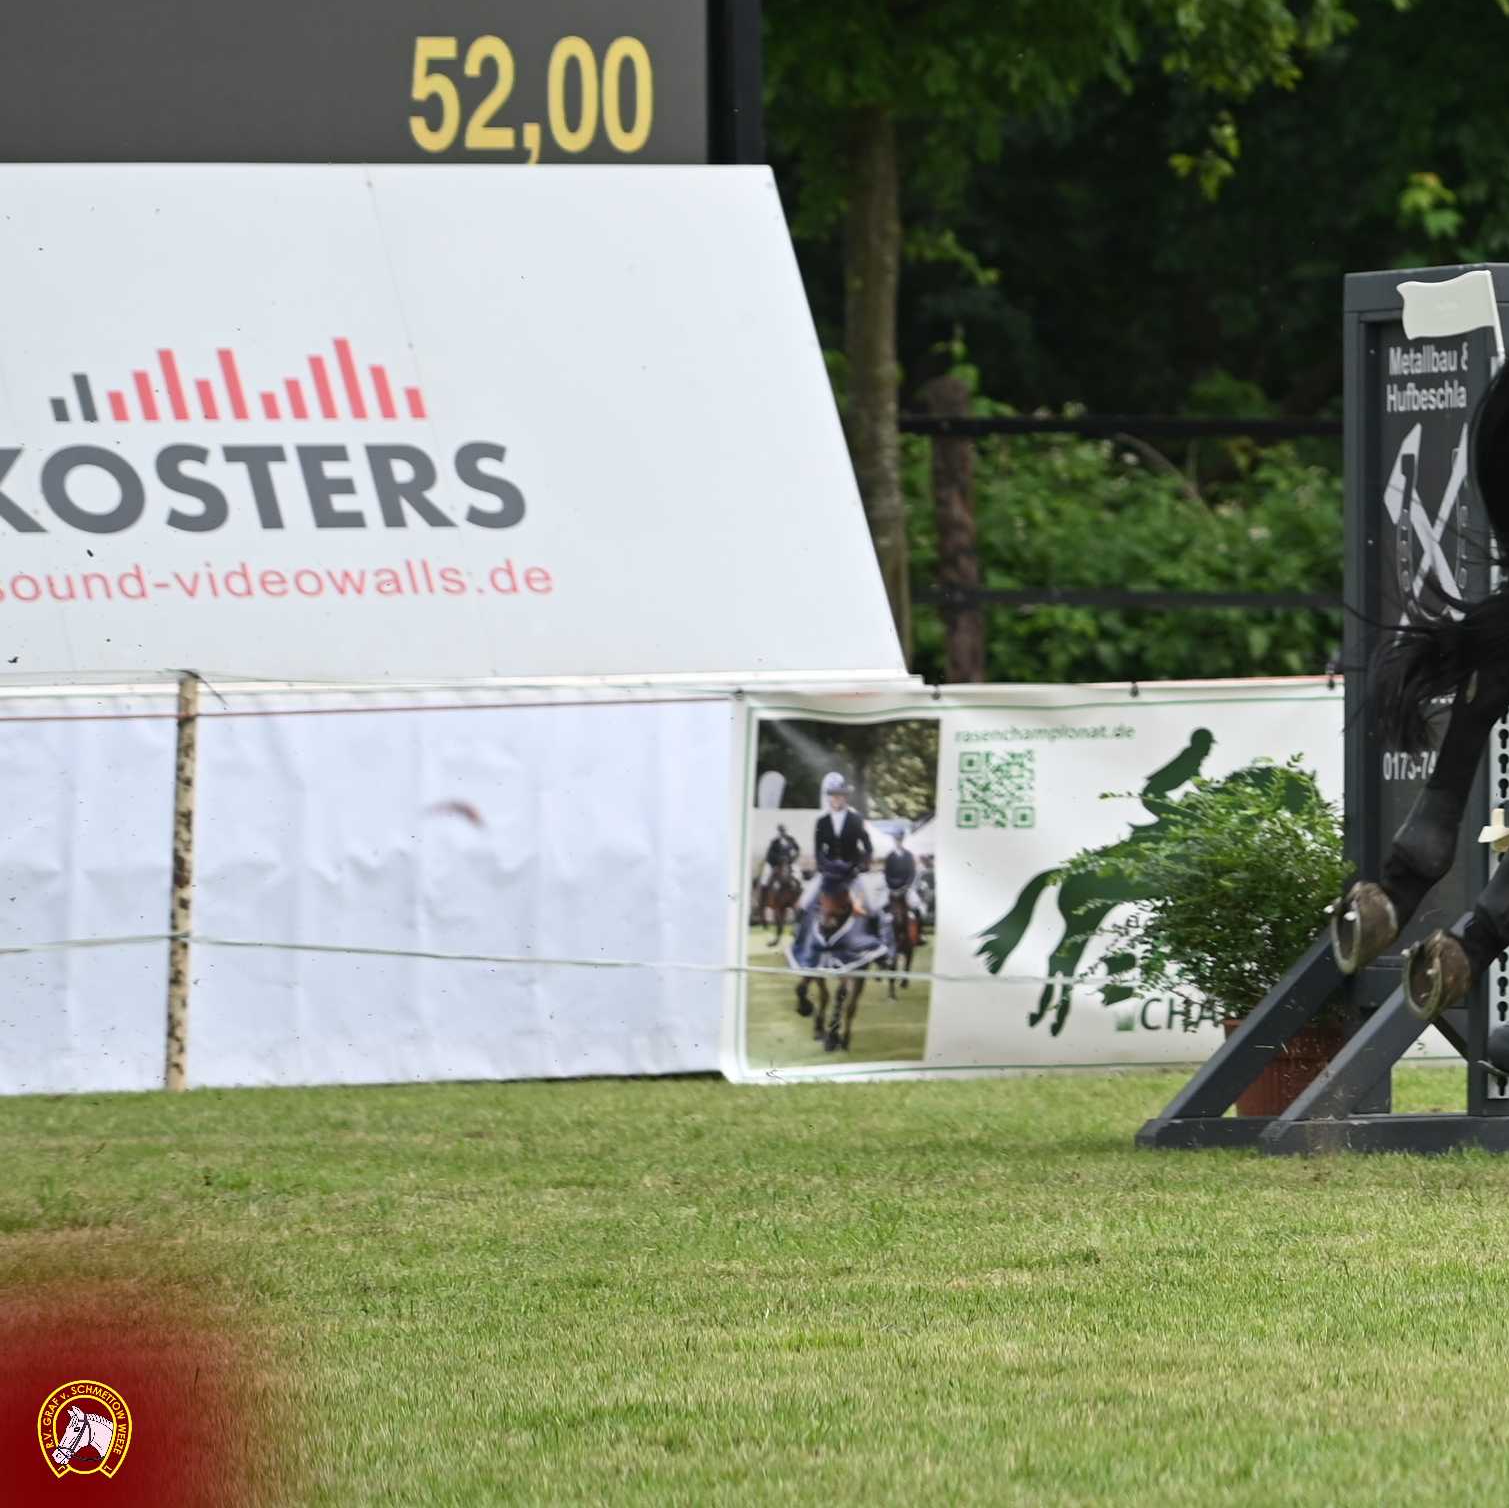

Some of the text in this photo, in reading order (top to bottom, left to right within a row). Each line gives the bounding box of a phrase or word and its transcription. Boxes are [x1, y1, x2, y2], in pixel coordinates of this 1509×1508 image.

[409, 35, 653, 163] 52,00
[1389, 344, 1457, 375] Metallbau
[0, 559, 555, 604] ound-videowalls.de
